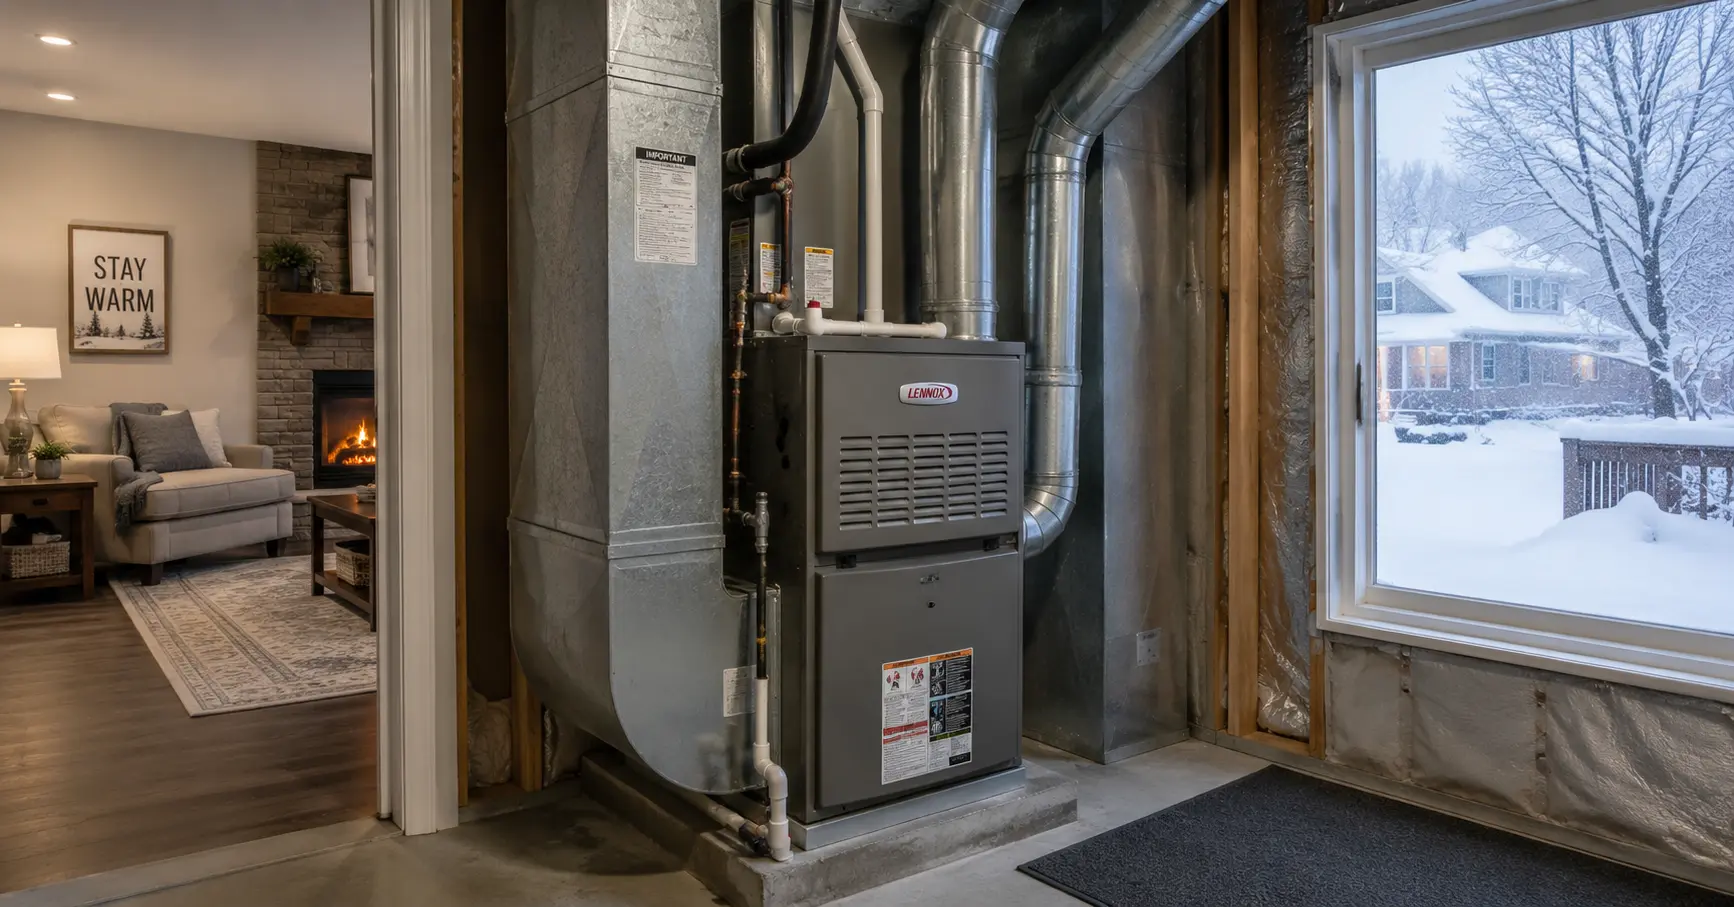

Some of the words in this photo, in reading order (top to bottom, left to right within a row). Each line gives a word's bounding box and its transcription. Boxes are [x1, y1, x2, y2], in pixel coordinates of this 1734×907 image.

[645, 150, 687, 163] IMPORTANT
[94, 255, 147, 281] STAY
[85, 286, 154, 313] WARM
[908, 387, 945, 399] LENNOX
